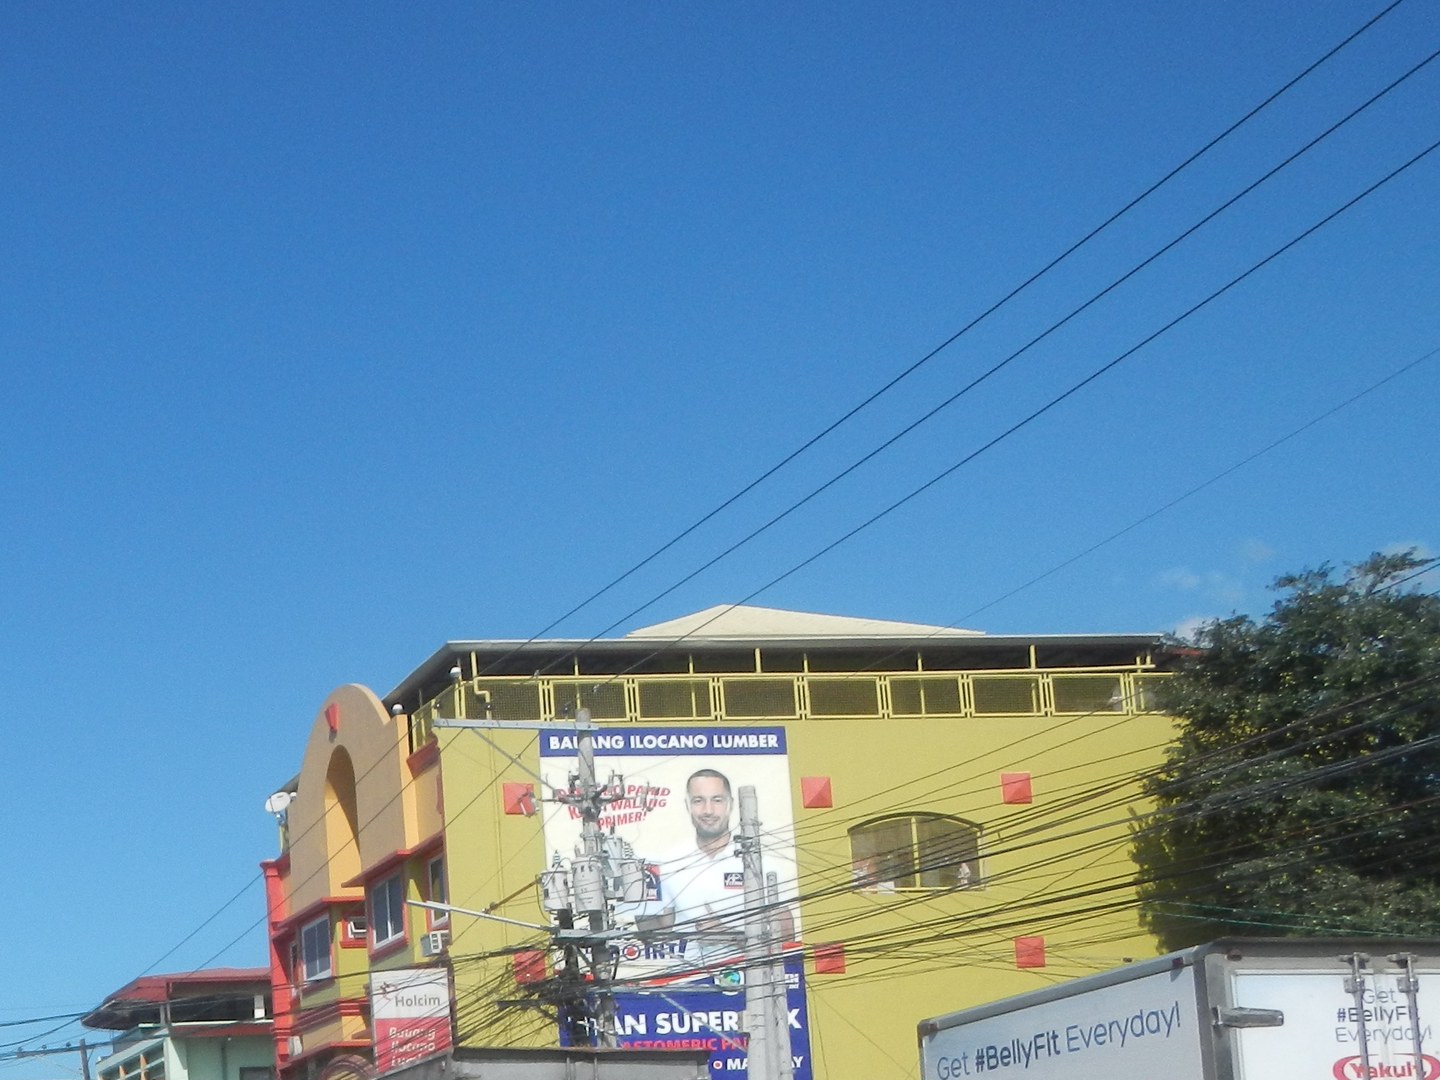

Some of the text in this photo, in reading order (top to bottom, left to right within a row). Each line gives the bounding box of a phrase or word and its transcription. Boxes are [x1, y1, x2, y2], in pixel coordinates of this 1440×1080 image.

[630, 735, 708, 749] ILOCANO
[713, 734, 779, 748] LUMBER
[394, 994, 441, 1007] Holcim
[1362, 987, 1398, 1004] Get
[655, 1010, 739, 1035] SUPER
[1337, 1005, 1408, 1024] #BellyF
[937, 1001, 1182, 1080] Get #BellyFit Everyday!
